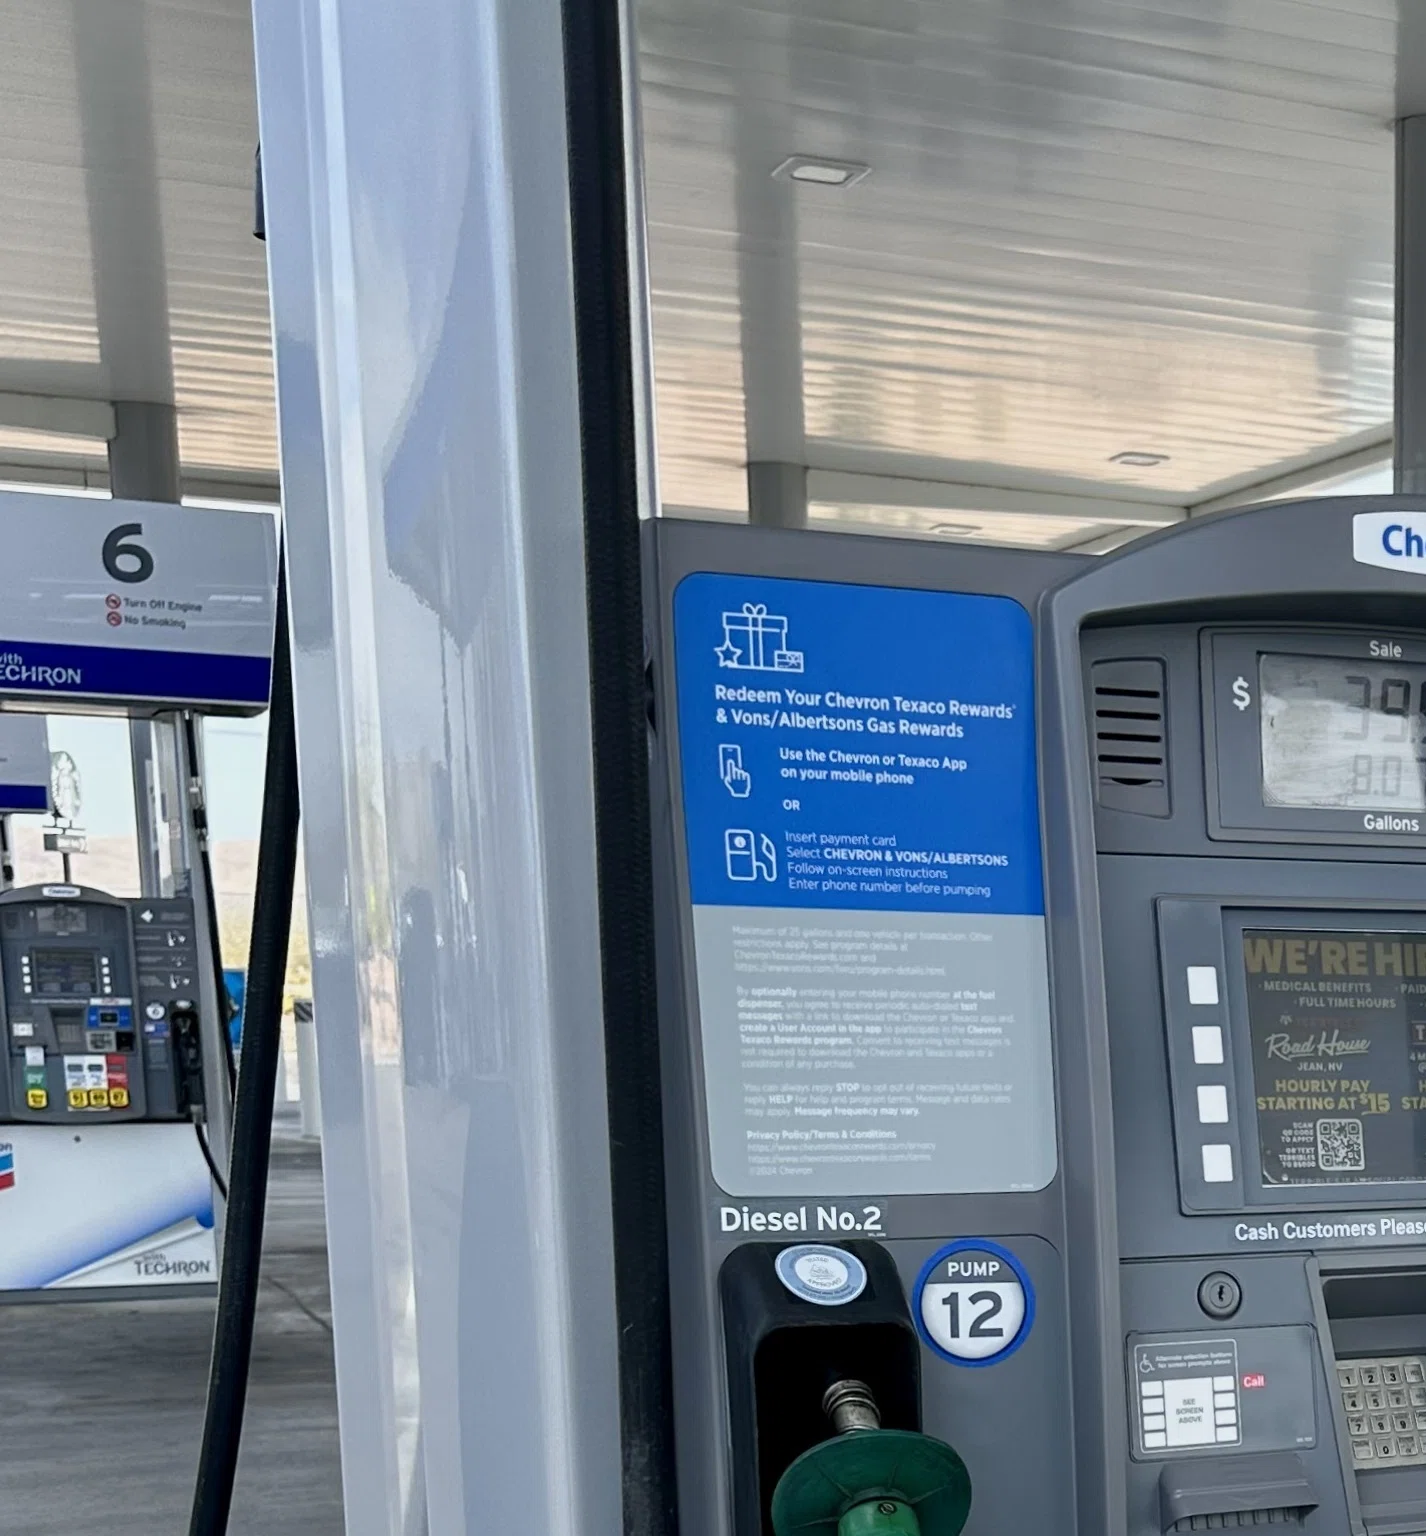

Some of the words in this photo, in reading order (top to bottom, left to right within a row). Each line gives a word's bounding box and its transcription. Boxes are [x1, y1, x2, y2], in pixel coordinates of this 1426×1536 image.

[102, 523, 154, 583] 6
[124, 597, 147, 608] Turn
[149, 599, 165, 610] Off
[168, 601, 202, 612] Engine
[125, 615, 139, 625] No
[142, 616, 186, 629] Smoking
[1370, 641, 1402, 659] Sale
[715, 684, 781, 704] Redeem
[785, 689, 821, 706] Your
[825, 692, 889, 712] Chevron
[893, 697, 945, 715] Texaco
[716, 712, 727, 724] &
[732, 711, 864, 733] Vons/Albertsons
[867, 720, 895, 735] Gas
[899, 721, 963, 738] Rewards
[780, 748, 803, 761] Use
[806, 750, 826, 763] the
[829, 750, 880, 767] Chevron
[883, 756, 895, 767] or
[899, 754, 939, 770] Texaco
[943, 757, 967, 772] App
[781, 768, 797, 779] on
[800, 768, 828, 782] your
[831, 768, 872, 783] mobile
[876, 771, 914, 785] phone
[783, 800, 800, 811] OR
[1364, 815, 1419, 832] Gallons
[785, 831, 818, 844] Insert
[821, 832, 869, 848] payment
[872, 835, 896, 847] card
[787, 846, 821, 860] Select
[824, 848, 882, 862] CHEVRON
[895, 851, 1008, 867] VONS/ALBERTSONS
[788, 863, 824, 875] Follow
[828, 865, 882, 878] on-screen
[885, 866, 948, 880] instructions
[789, 878, 819, 891] Enter
[822, 879, 857, 893] phone
[860, 880, 902, 894] number
[905, 882, 940, 896] before
[943, 884, 991, 898] pumping
[1245, 938, 1369, 975] WE'RE
[1264, 981, 1316, 992] MEDICAL
[1319, 983, 1372, 993] BENEFITS
[1401, 984, 1426, 994] PAID
[1265, 1033, 1315, 1061] Road
[1317, 1029, 1371, 1056] House
[836, 1082, 860, 1093] STOP
[1275, 1079, 1336, 1093] HOURLY
[1340, 1080, 1370, 1094] PAY
[769, 1094, 793, 1105] HELP
[1257, 1097, 1335, 1111] STARTING
[1338, 1097, 1356, 1110] AT
[721, 1206, 806, 1232] Diesel
[817, 1206, 881, 1231] No.2
[1235, 1223, 1279, 1241] Cash
[1283, 1218, 1376, 1240] Customers
[134, 1260, 210, 1277] TECHRON
[948, 1261, 1000, 1276] PUMP
[942, 1290, 1003, 1339] 12
[1243, 1377, 1265, 1387] Call
